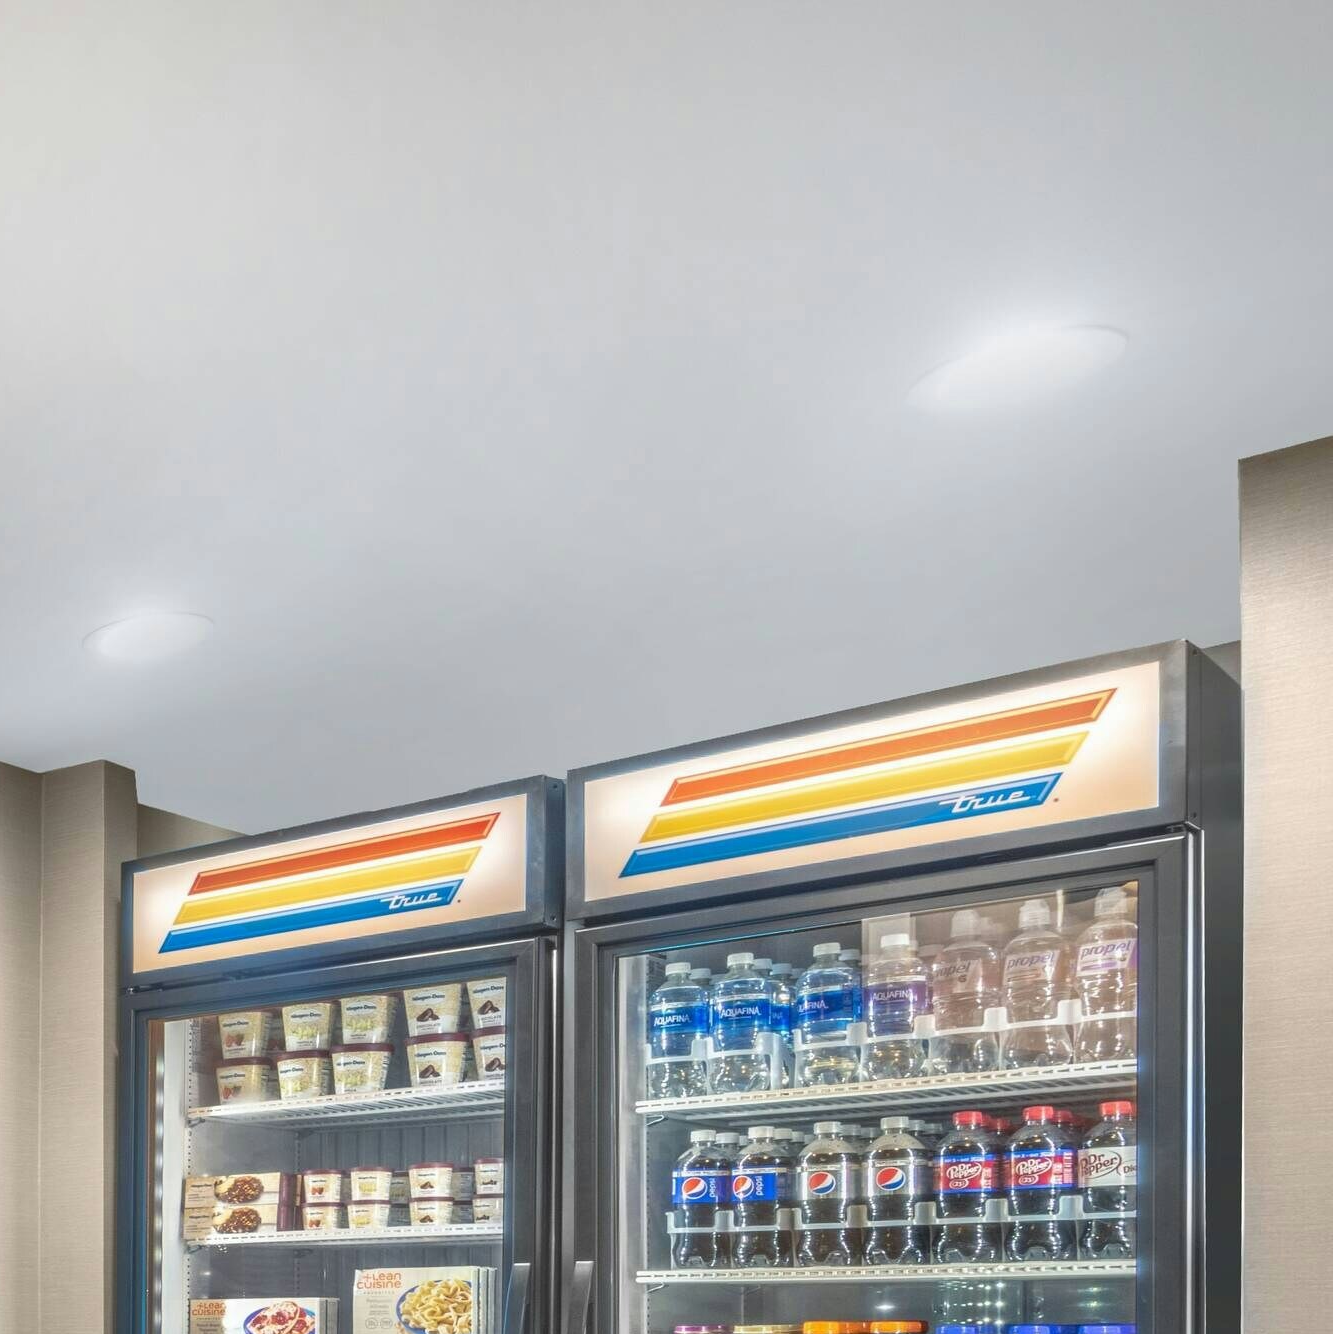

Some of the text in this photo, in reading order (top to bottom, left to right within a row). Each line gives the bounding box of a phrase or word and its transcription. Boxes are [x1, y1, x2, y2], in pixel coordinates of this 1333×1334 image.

[939, 790, 1031, 813] true
[380, 892, 441, 910] true
[1080, 941, 1132, 959] propel
[1007, 952, 1055, 969] propel
[721, 1006, 760, 1018] AQUAFINA
[654, 1014, 690, 1026] AQUAFINA
[1027, 1158, 1038, 1166] Dr
[1088, 1154, 1104, 1165] Dr
[947, 1166, 980, 1179] Pepper
[959, 1163, 970, 1171] Dr
[1017, 1160, 1051, 1175] Pepper
[373, 1271, 402, 1281] Lean
